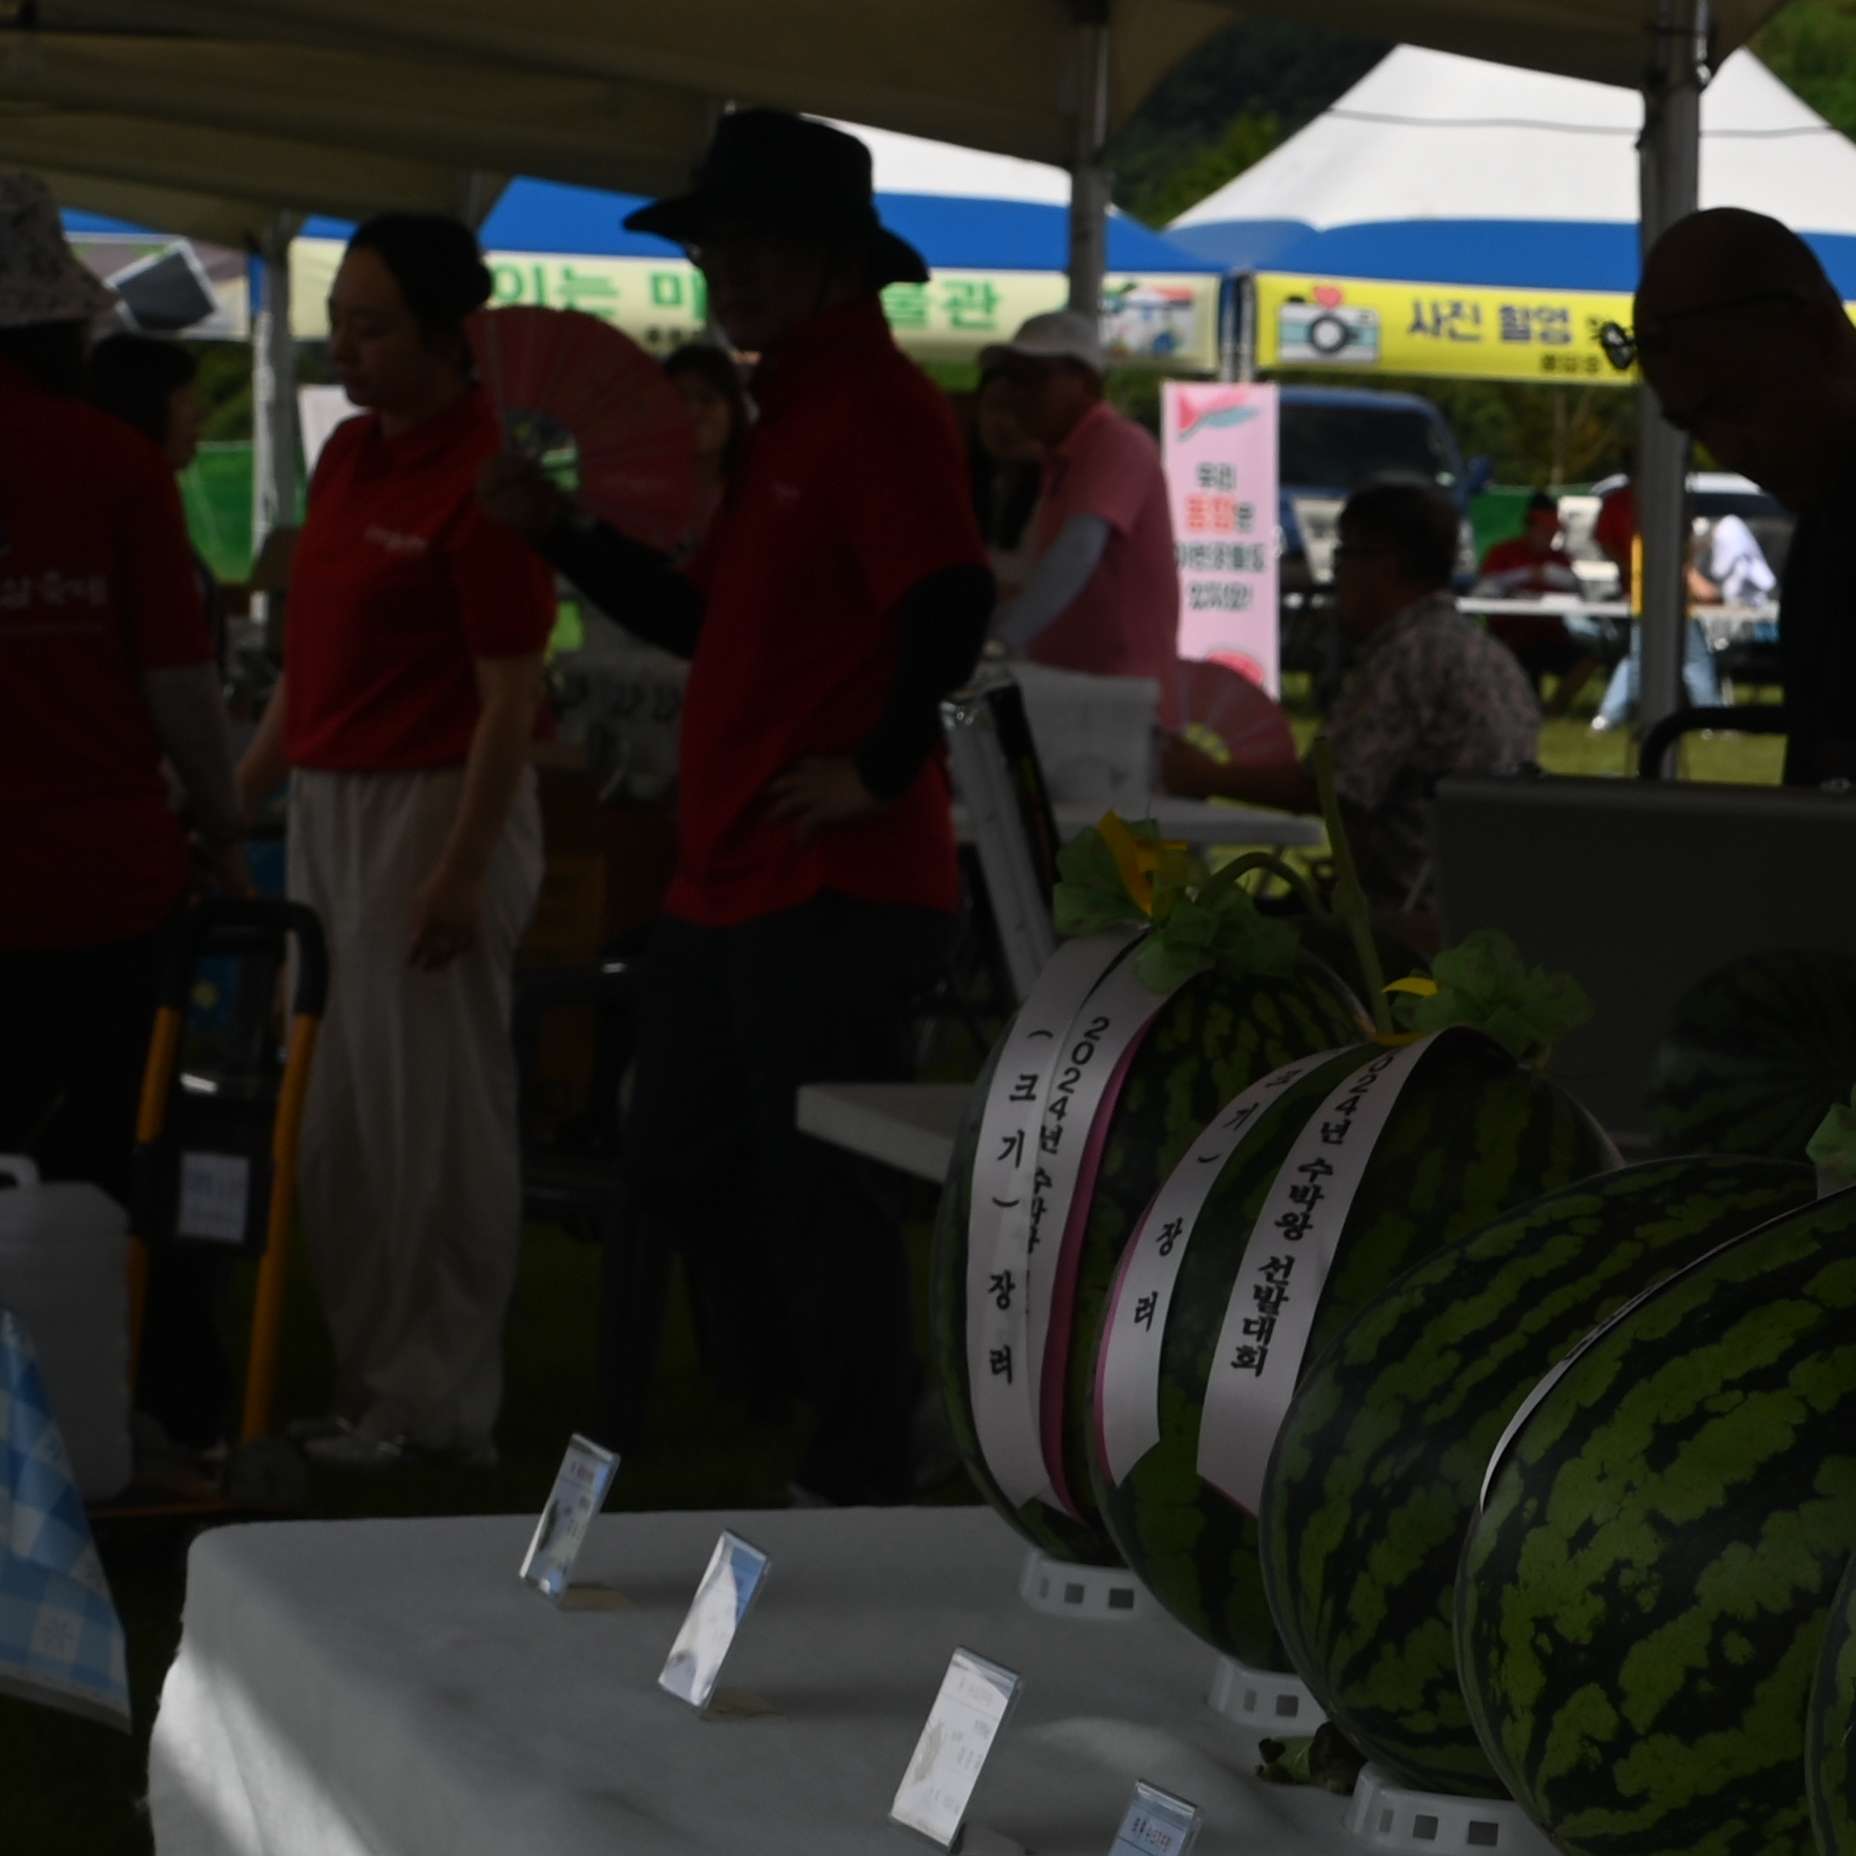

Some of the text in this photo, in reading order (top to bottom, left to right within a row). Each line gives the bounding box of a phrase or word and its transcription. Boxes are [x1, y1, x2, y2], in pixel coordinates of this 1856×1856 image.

[1037, 1015, 1111, 1155] 2024년
[1134, 1215, 1184, 1333] 장려
[1230, 1050, 1398, 1378] 024년 수박왕 선발대회
[987, 1270, 1016, 1385] 장려
